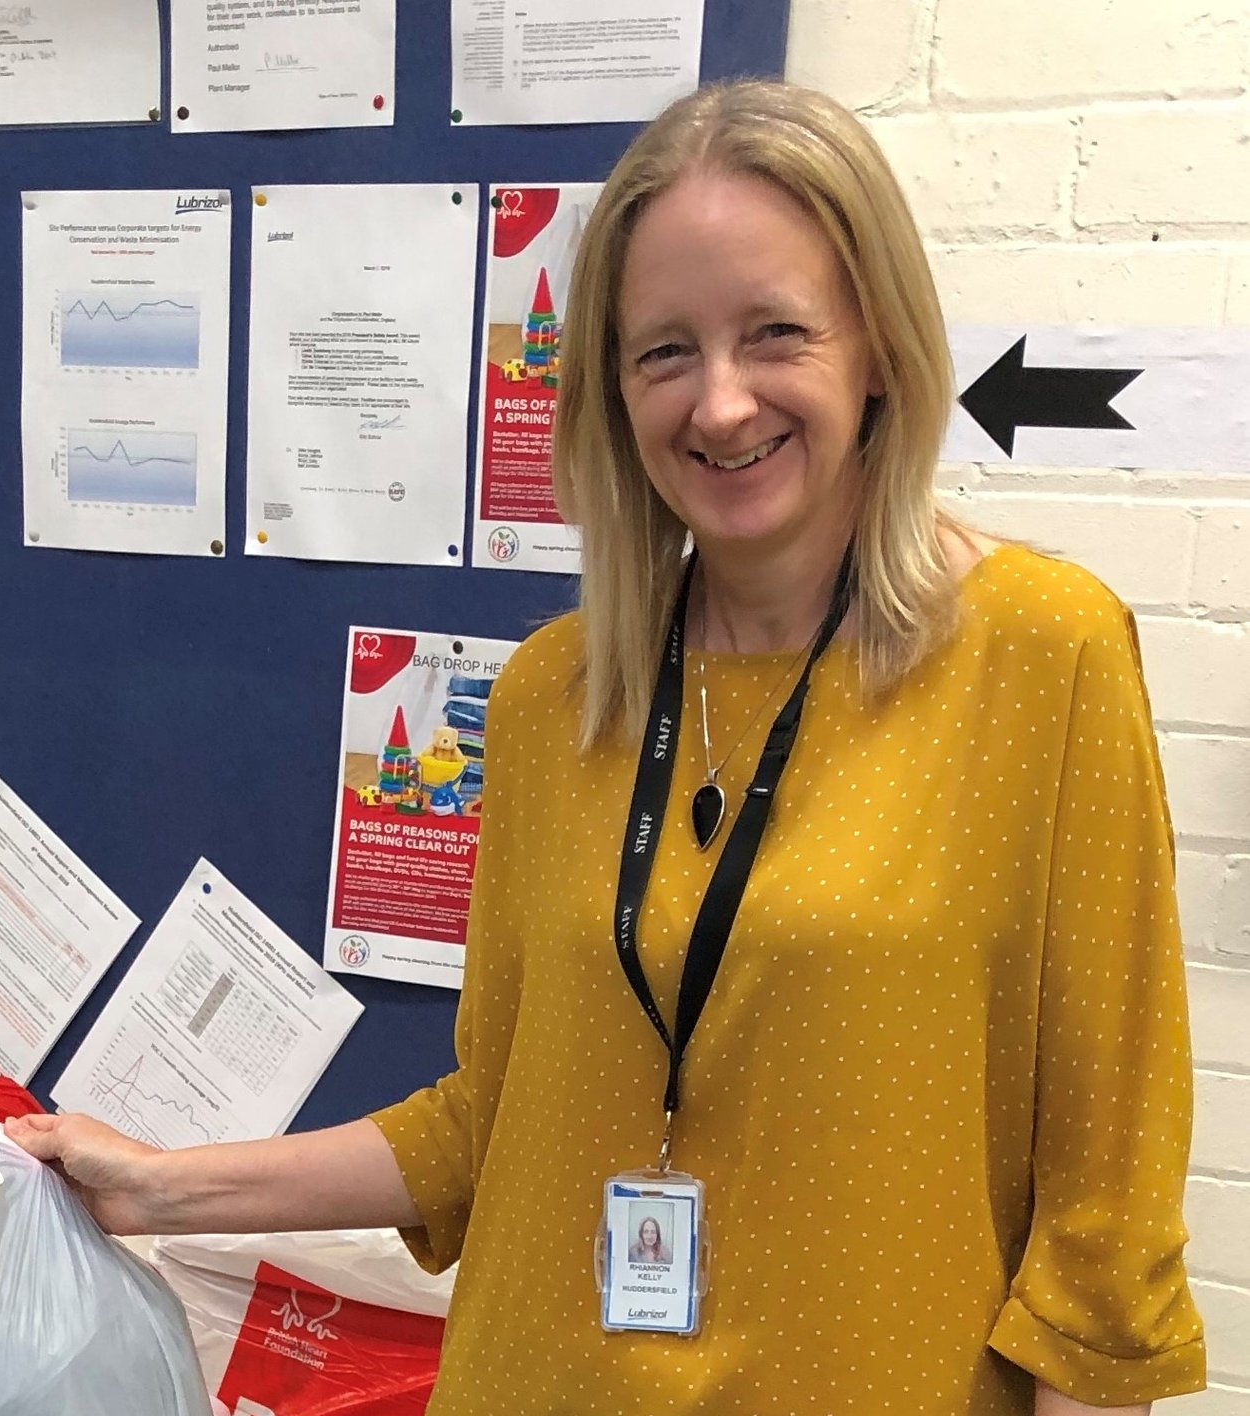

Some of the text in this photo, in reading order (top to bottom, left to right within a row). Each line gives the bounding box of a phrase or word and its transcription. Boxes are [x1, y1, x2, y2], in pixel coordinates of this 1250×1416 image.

[176, 196, 224, 208] Lubrizo
[60, 224, 96, 232] Performance
[117, 224, 147, 233] Corporate
[148, 225, 170, 233] targets
[171, 224, 180, 232] for
[182, 224, 202, 233] Energy
[70, 236, 179, 244] Conservation and Waste Minimisation
[494, 398, 547, 411] BAGS OF
[494, 412, 550, 425] A SPRING
[412, 654, 506, 675] BAG DROP HE
[654, 713, 672, 761] STAFF
[350, 819, 381, 832] BAGS
[384, 823, 400, 834] OF
[402, 825, 458, 841] REASONS
[633, 812, 653, 854] STAFF
[349, 831, 470, 855] A SPRING CLEAR OUT
[76, 876, 104, 906] Management
[221, 910, 249, 938] Management
[621, 905, 633, 950] STAFF
[629, 1264, 671, 1273] RHIANNON
[637, 1273, 662, 1281] KELLY
[622, 1285, 678, 1295] HUDDERSFIELD
[627, 1308, 668, 1320] Lubrizol
[263, 1337, 325, 1371] Foundation
[266, 1327, 328, 1360] British Heart
